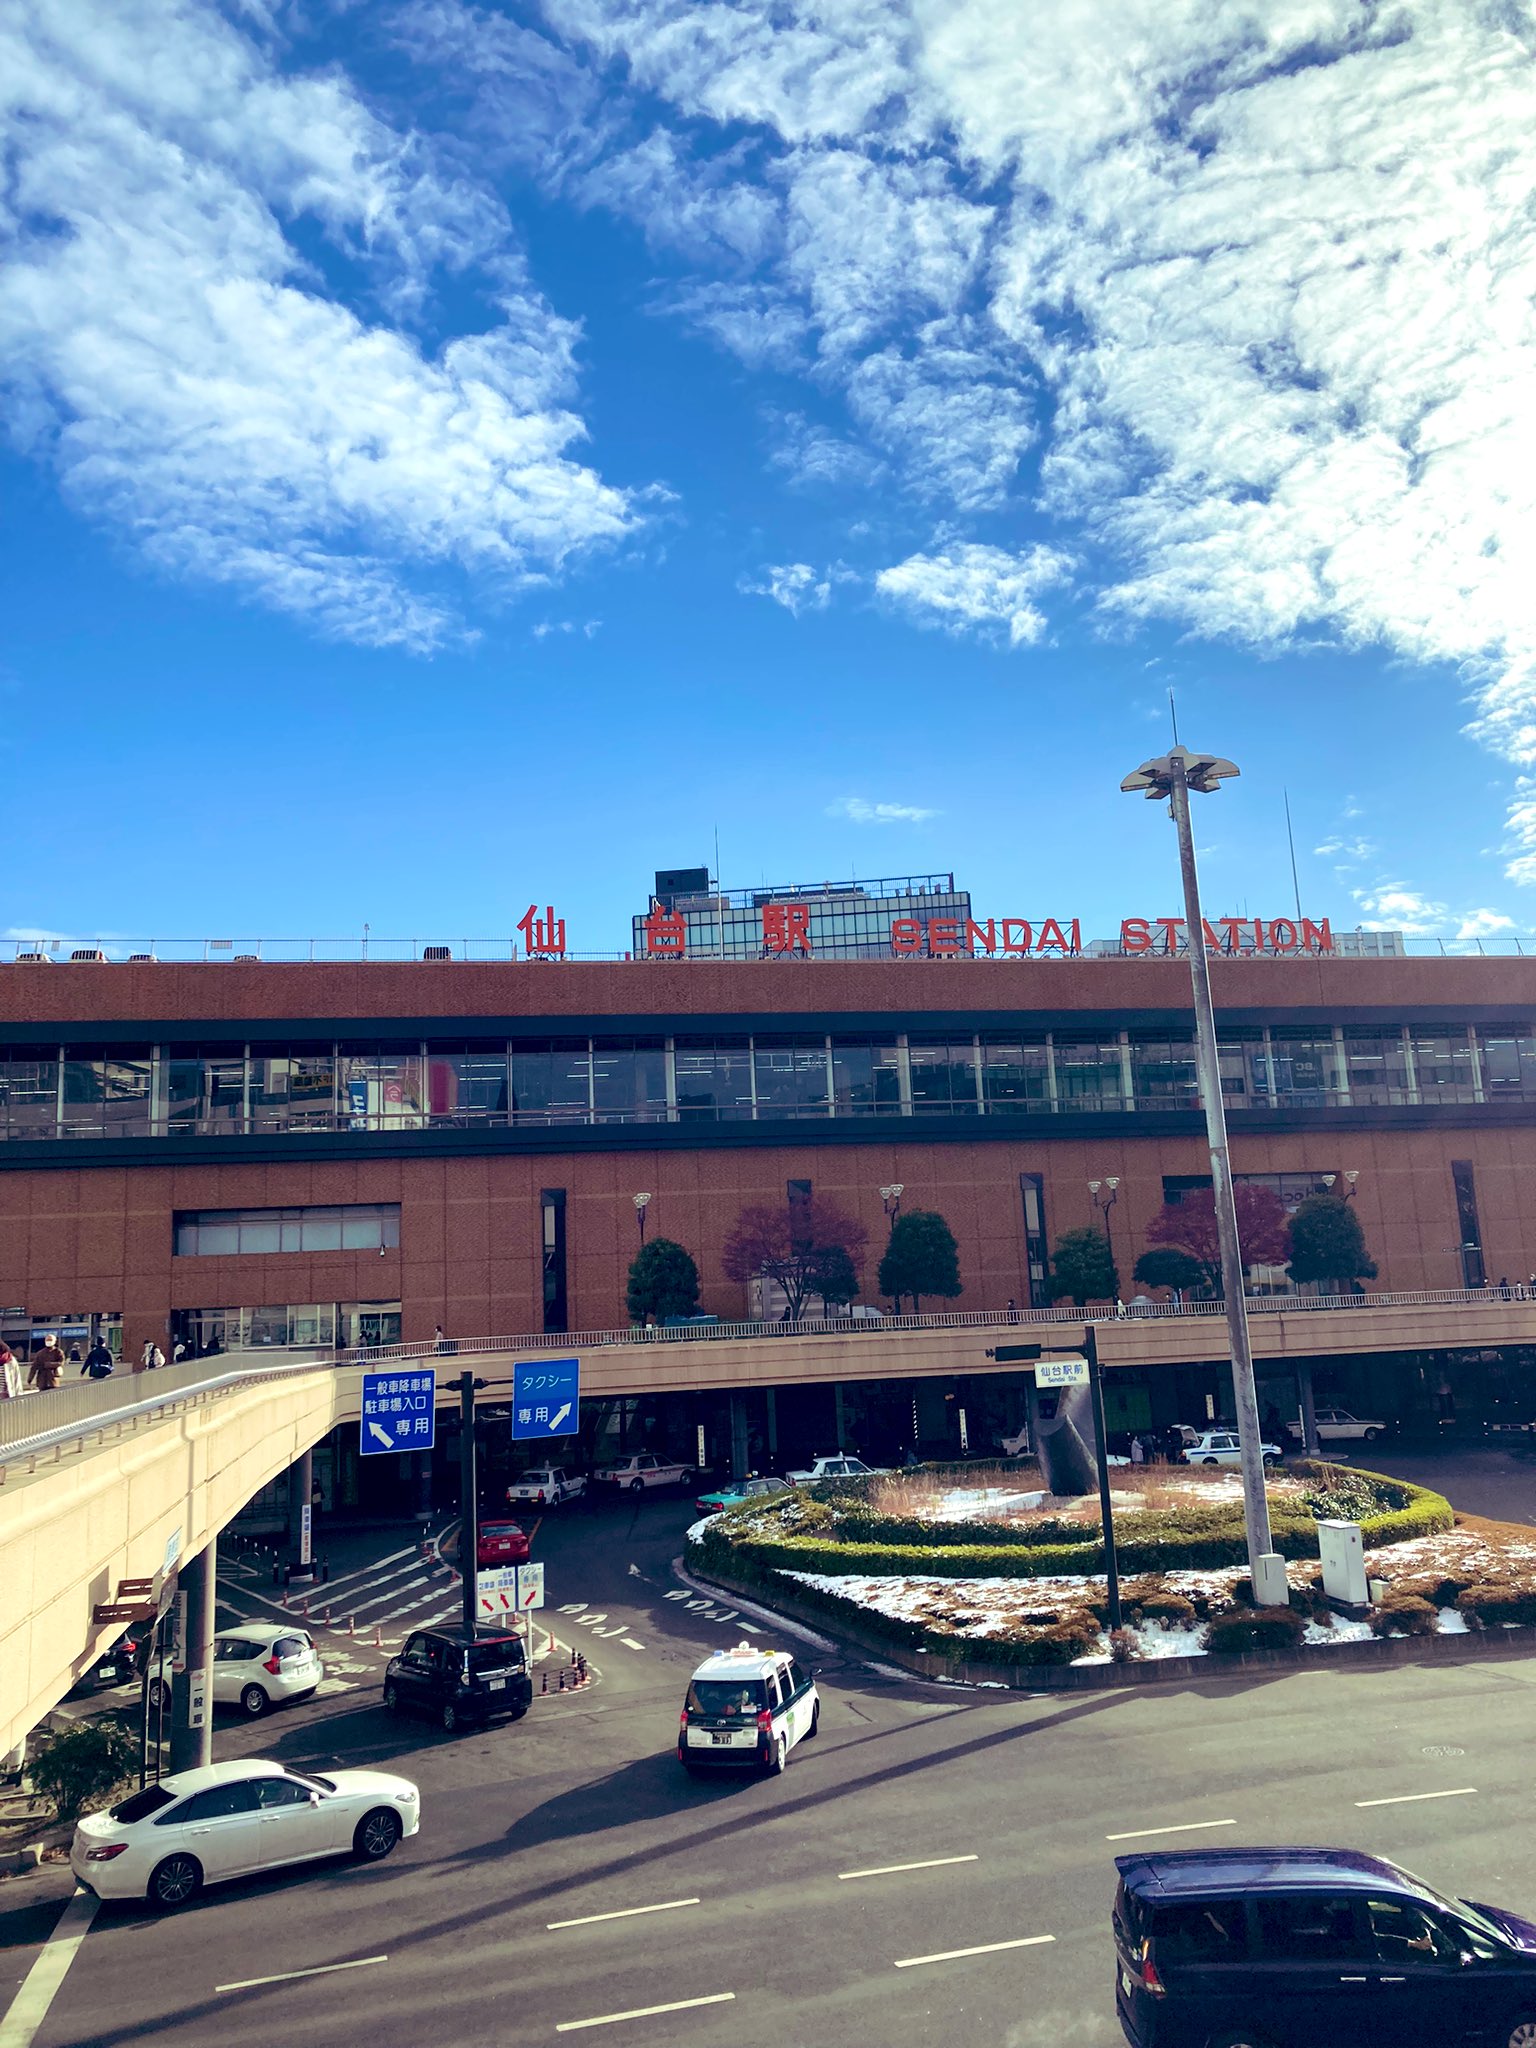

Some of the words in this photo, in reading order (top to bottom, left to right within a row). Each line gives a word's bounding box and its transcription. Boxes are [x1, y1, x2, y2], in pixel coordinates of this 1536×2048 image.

[517, 904, 812, 953] 仙台駅
[892, 918, 1083, 953] SENDAI
[1040, 1364, 1084, 1377] 仙台駅前
[365, 1377, 432, 1395] 一般車降車場
[522, 1374, 572, 1391] タクシー
[364, 1396, 427, 1414] 駐車場入口
[517, 1406, 549, 1424] 専用
[395, 1417, 429, 1436] 専用
[662, 1590, 762, 1634] タクシー
[556, 1603, 646, 1650] タクシー
